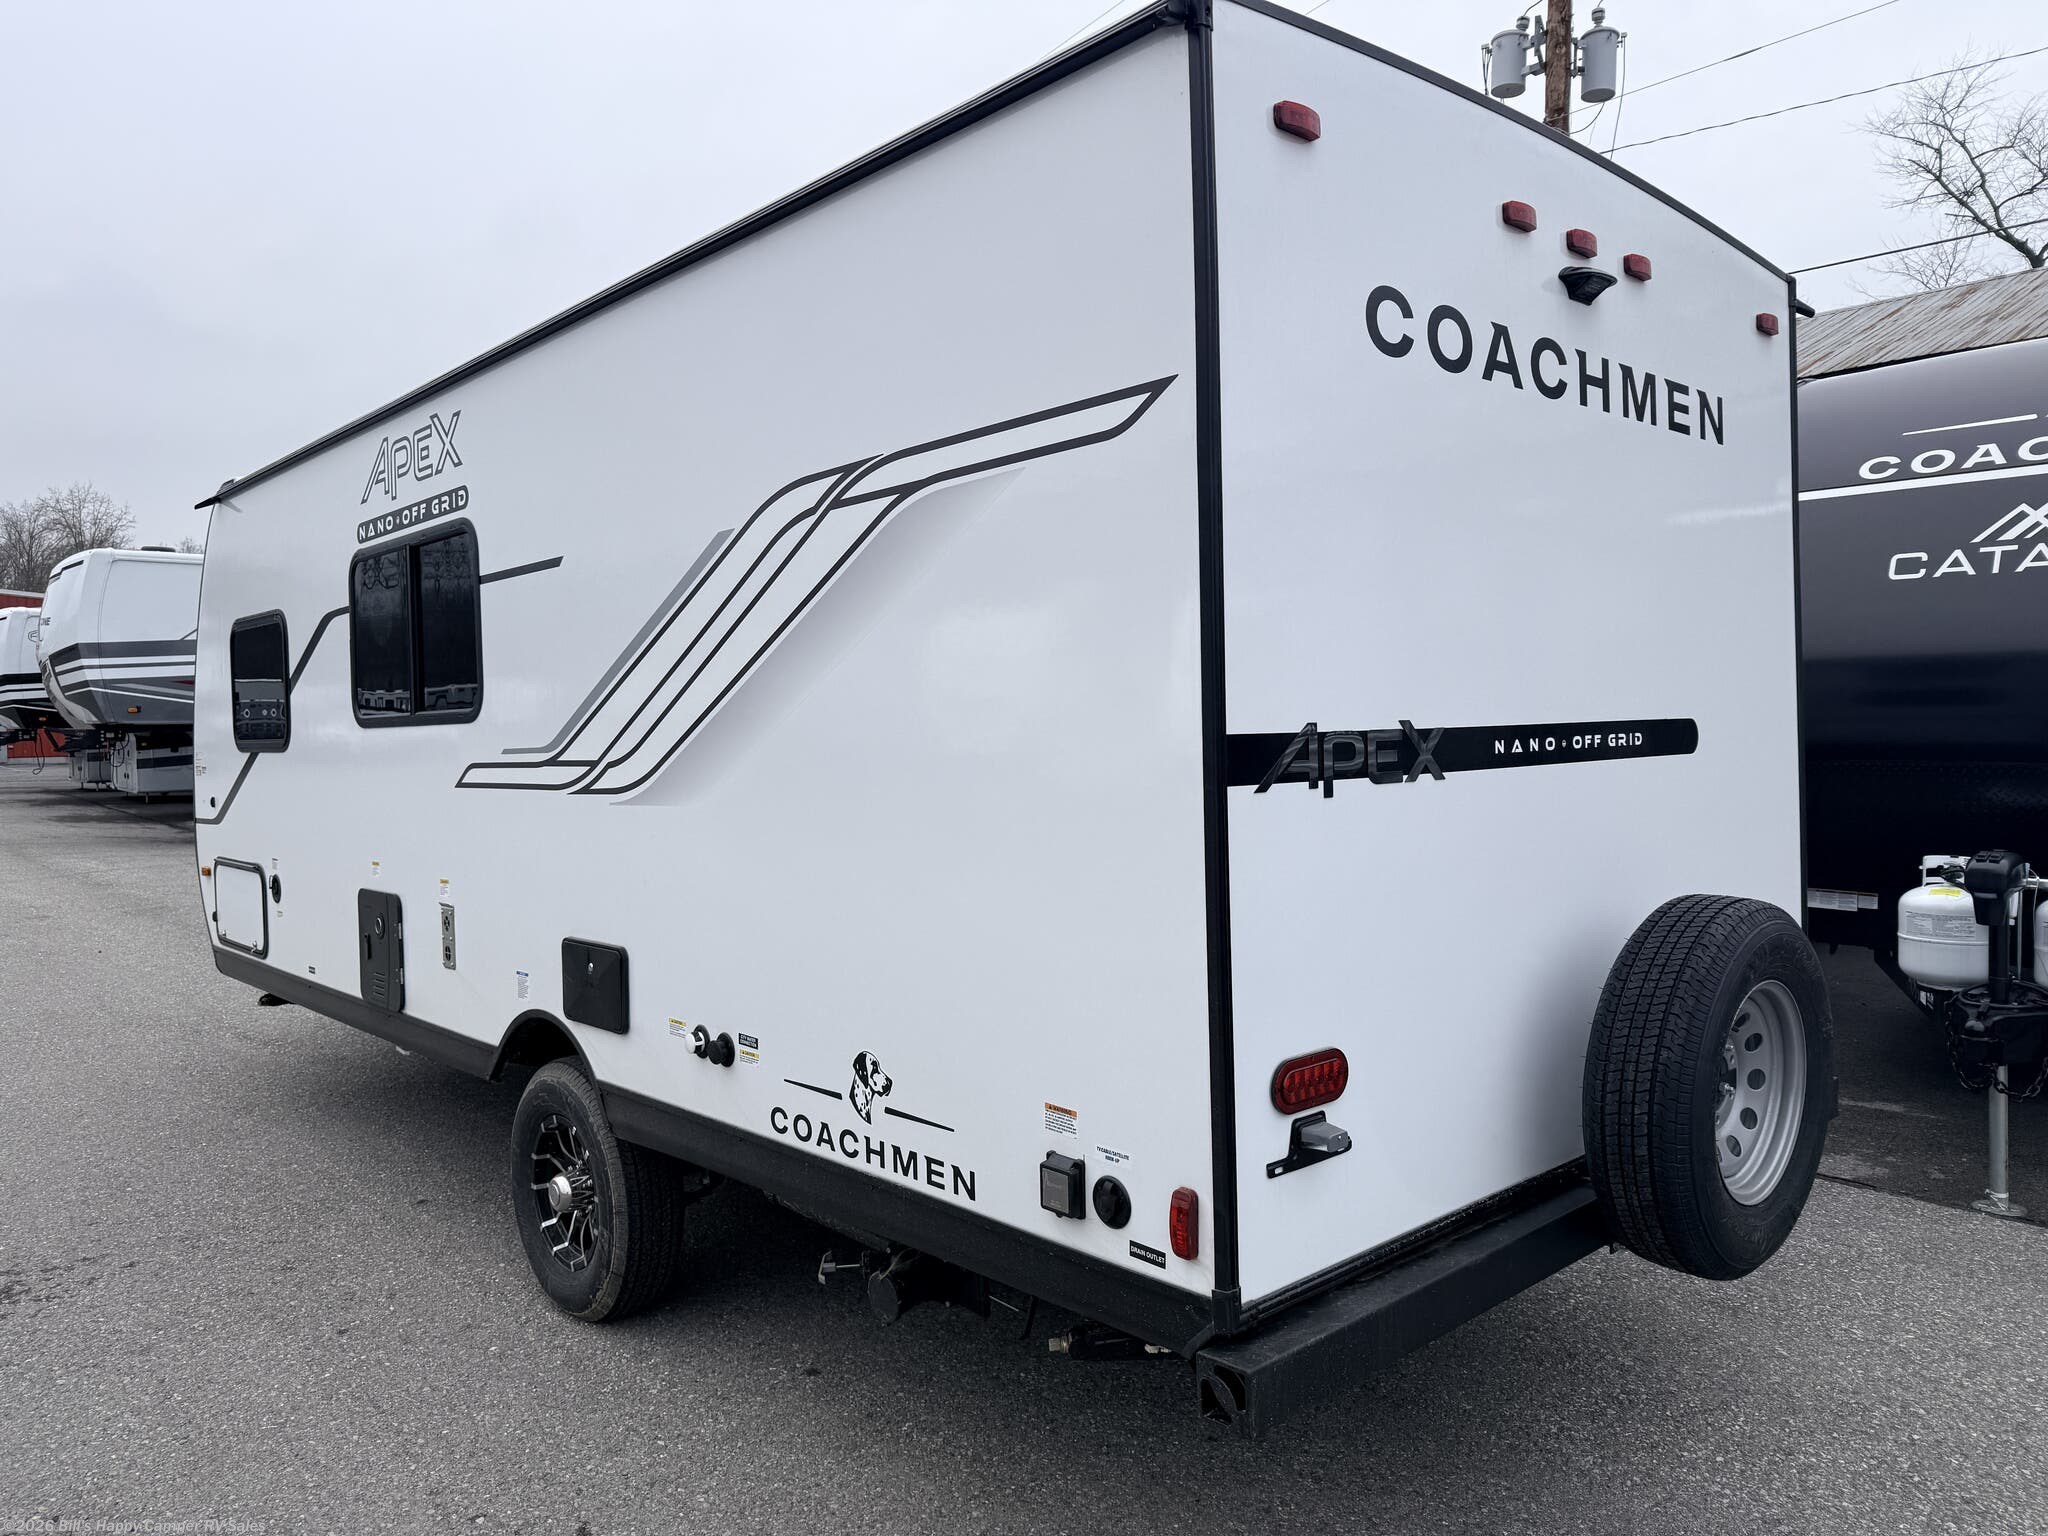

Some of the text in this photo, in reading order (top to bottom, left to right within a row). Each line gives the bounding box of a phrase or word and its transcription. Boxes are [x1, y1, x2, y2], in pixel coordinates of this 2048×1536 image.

[1365, 285, 1724, 446] COACHMEN
[360, 409, 464, 505] APEX
[359, 489, 467, 540] NANO OFF GRID
[1253, 719, 1446, 799] APEX
[1494, 732, 1643, 754] NANO OFF GRID
[770, 1106, 976, 1202] COACHMEN
[1130, 1245, 1165, 1263] DRAIN OUTLET
